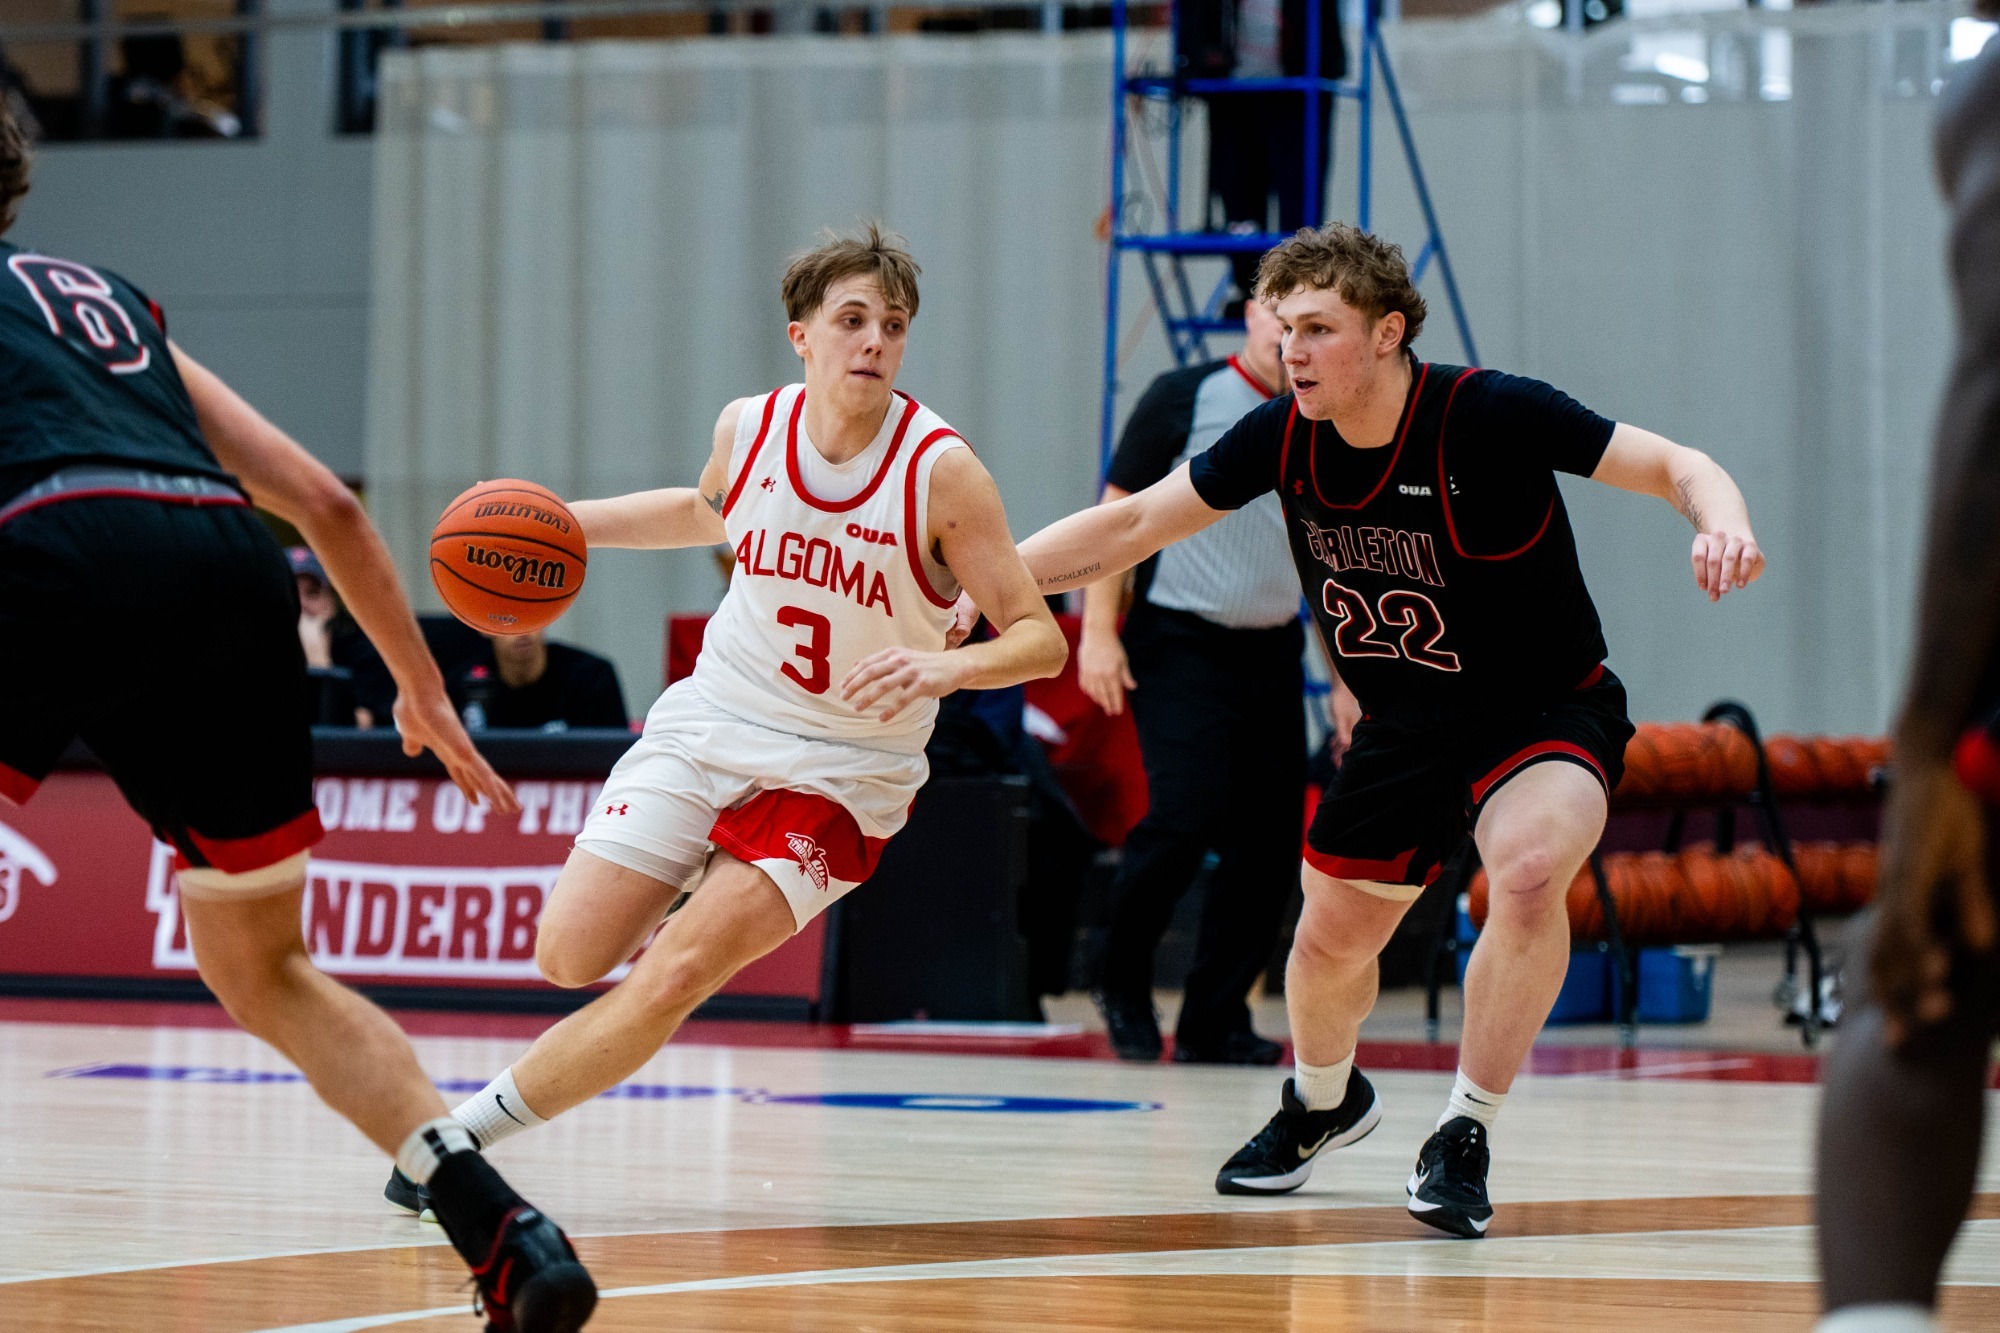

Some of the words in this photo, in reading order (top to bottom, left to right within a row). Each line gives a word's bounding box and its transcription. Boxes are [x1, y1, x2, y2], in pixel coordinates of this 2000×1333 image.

[7, 254, 150, 374] 6
[1398, 484, 1432, 496] OUA
[474, 503, 570, 535] EVOLUTION
[846, 523, 898, 546] OUA
[466, 544, 566, 588] Wilson
[736, 529, 893, 617] ALGOMA
[777, 606, 831, 694] 3
[1323, 578, 1461, 672] 22
[312, 778, 419, 832] OME
